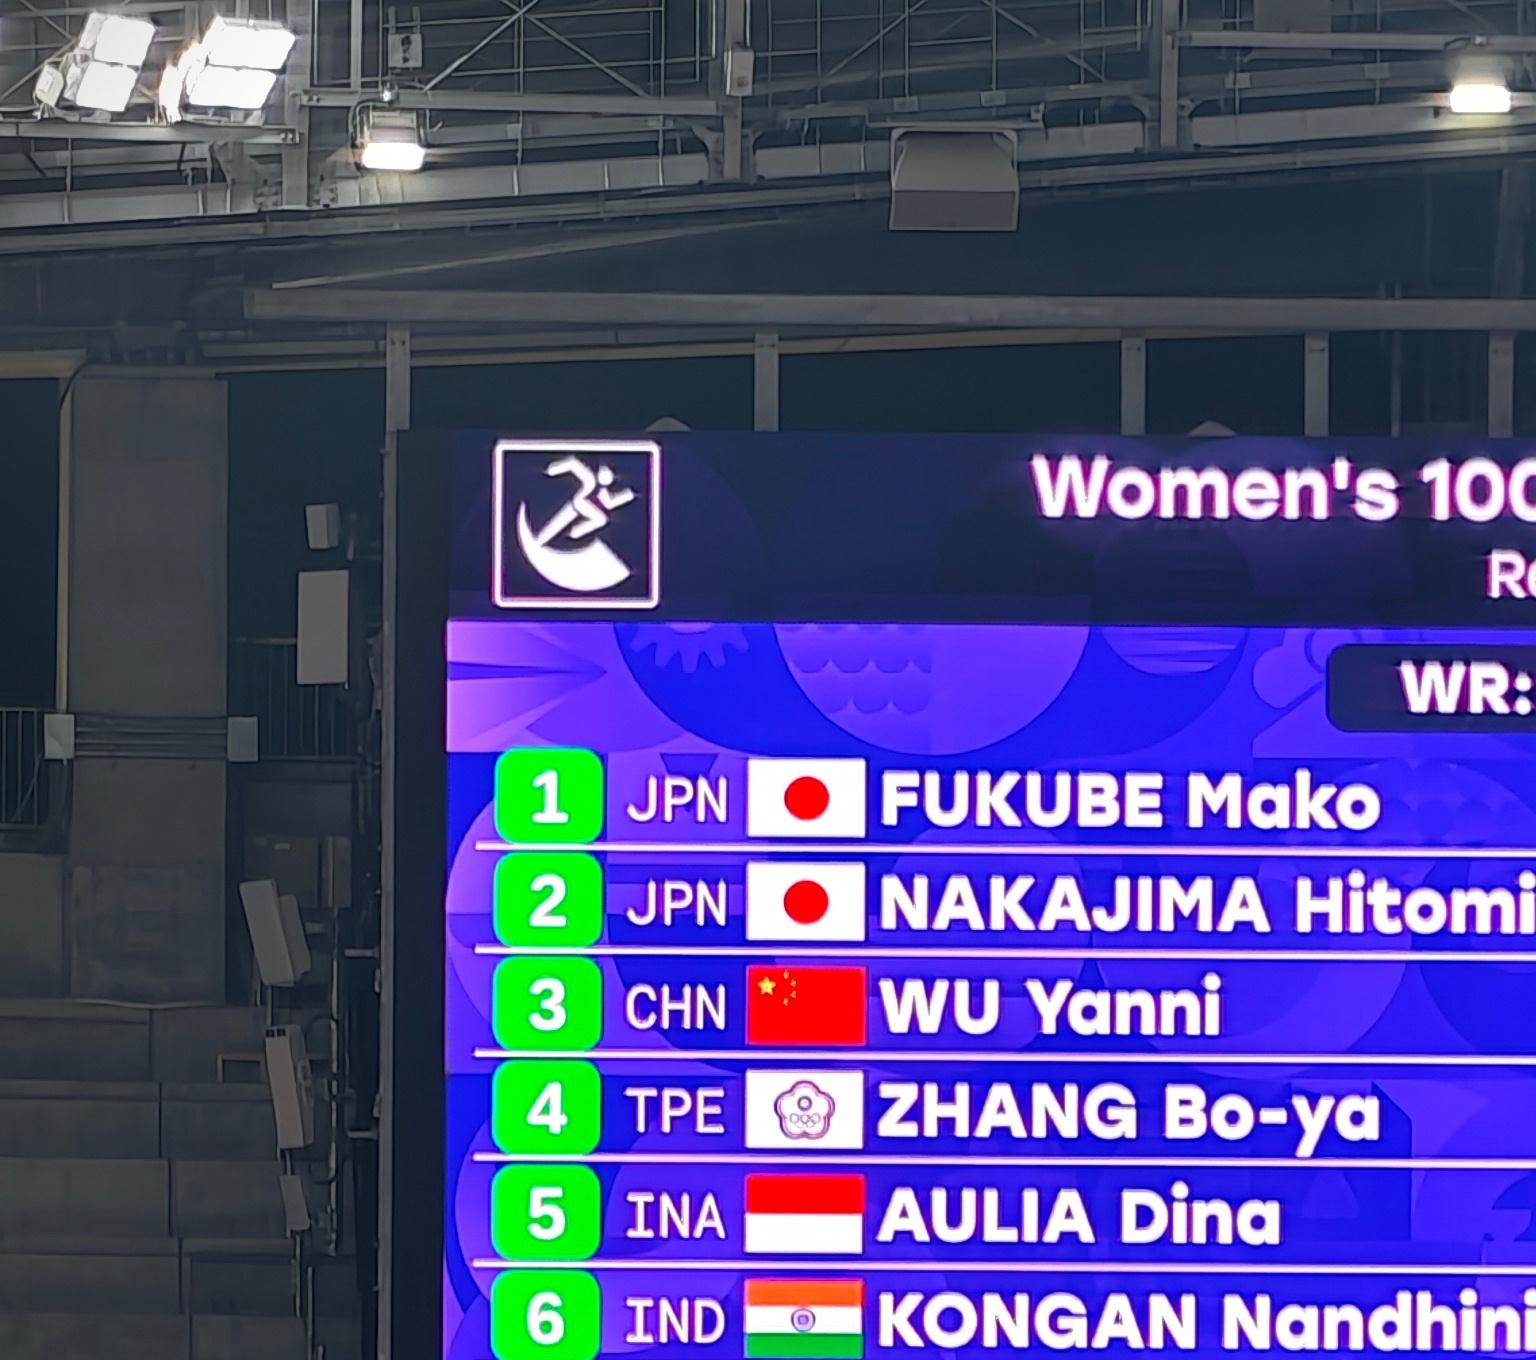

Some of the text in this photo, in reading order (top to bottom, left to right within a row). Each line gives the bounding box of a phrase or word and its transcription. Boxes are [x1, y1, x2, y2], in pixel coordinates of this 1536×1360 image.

[1033, 457, 1397, 520] Women's
[1401, 663, 1531, 714] WR:
[534, 771, 567, 822] 1
[628, 777, 726, 821] JPN
[883, 773, 1162, 827] FUKUBE
[1189, 770, 1379, 829] Mako
[531, 875, 566, 926] 2
[628, 881, 726, 925] JPN
[882, 876, 1270, 932] NAKAJIMA
[1297, 871, 1536, 933] Hitomi
[531, 979, 565, 1030] 3
[627, 985, 725, 1029] CHN
[880, 980, 998, 1034] WU
[1026, 974, 1220, 1035] Yanni
[528, 1083, 567, 1133] 4
[626, 1089, 724, 1133] TPE
[879, 1084, 1136, 1139] ZHANG
[1166, 1083, 1379, 1156] Bo-ya
[530, 1188, 565, 1239] 5
[628, 1194, 724, 1238] INA
[878, 1189, 1094, 1242] AULIA
[1122, 1182, 1279, 1244] Dina
[528, 1293, 563, 1343] 6
[627, 1299, 724, 1343] IND
[880, 1293, 1195, 1348] KONGAN
